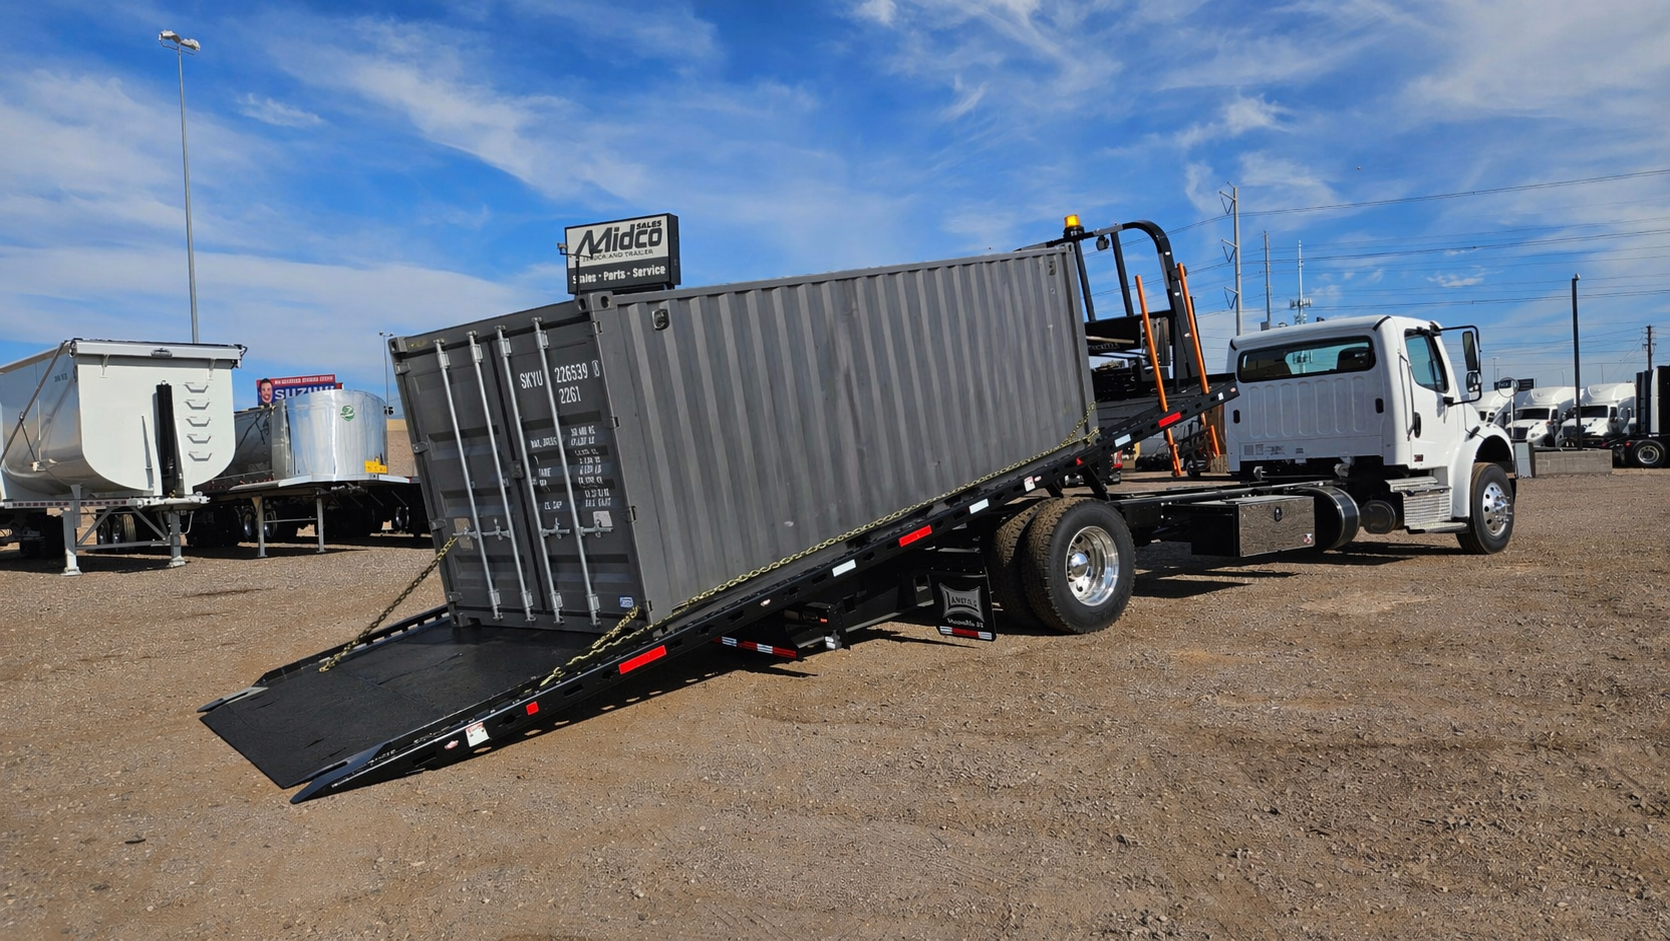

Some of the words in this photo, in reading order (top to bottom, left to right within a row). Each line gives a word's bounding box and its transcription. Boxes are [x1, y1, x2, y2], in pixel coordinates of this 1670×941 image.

[636, 220, 662, 230] SALES
[575, 224, 663, 255] Midco
[603, 269, 626, 281] Parts
[632, 264, 666, 278] Service
[520, 370, 543, 389] SKYU
[555, 362, 588, 383] 226539
[559, 386, 582, 404] 2261
